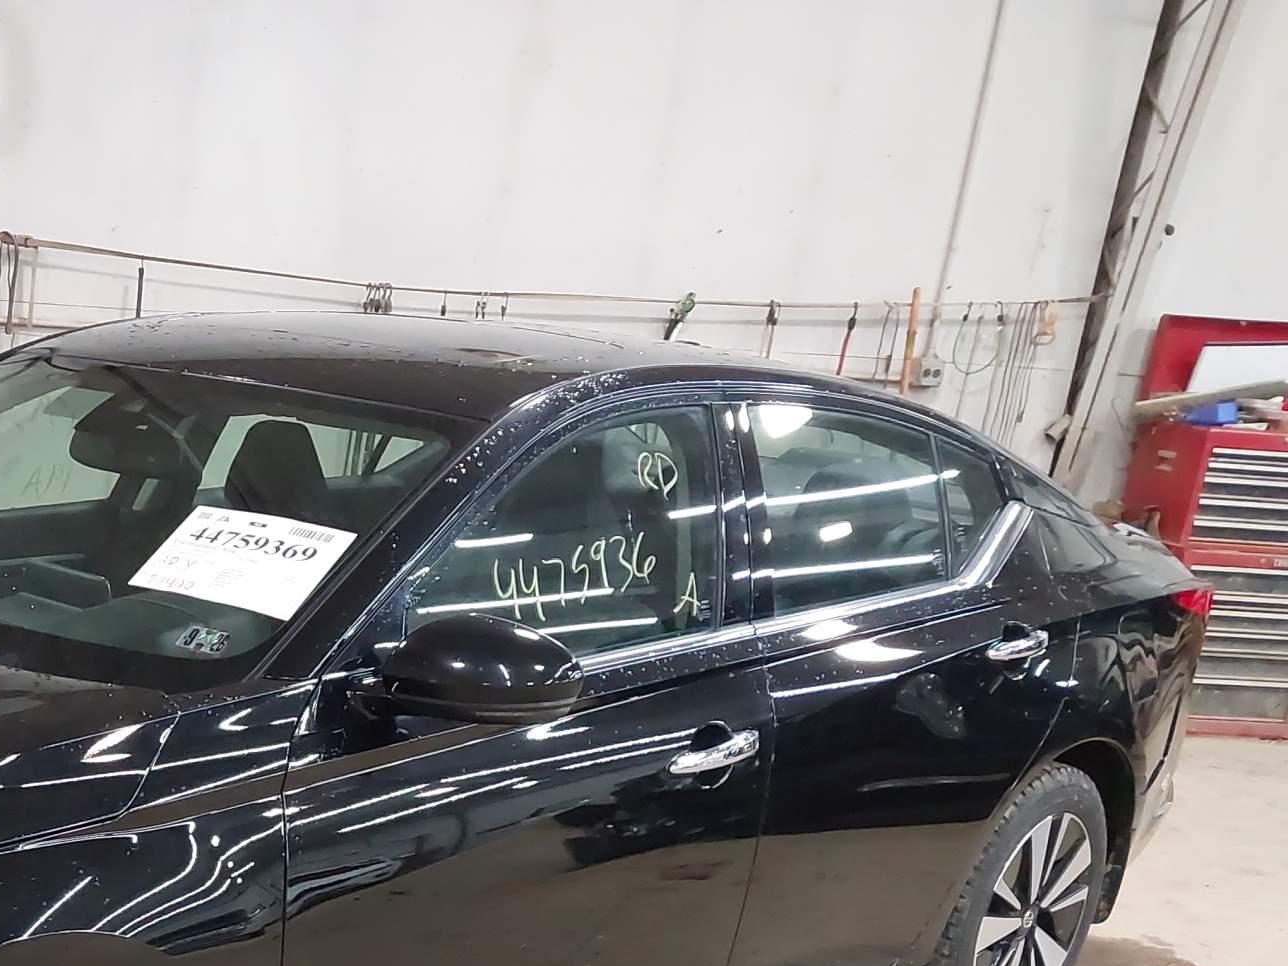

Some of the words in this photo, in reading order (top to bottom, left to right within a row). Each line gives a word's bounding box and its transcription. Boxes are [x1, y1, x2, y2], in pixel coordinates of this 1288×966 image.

[189, 526, 319, 563] 44759369
[492, 531, 657, 622] 4475936
[672, 572, 702, 617] A
[183, 628, 200, 646] 9
